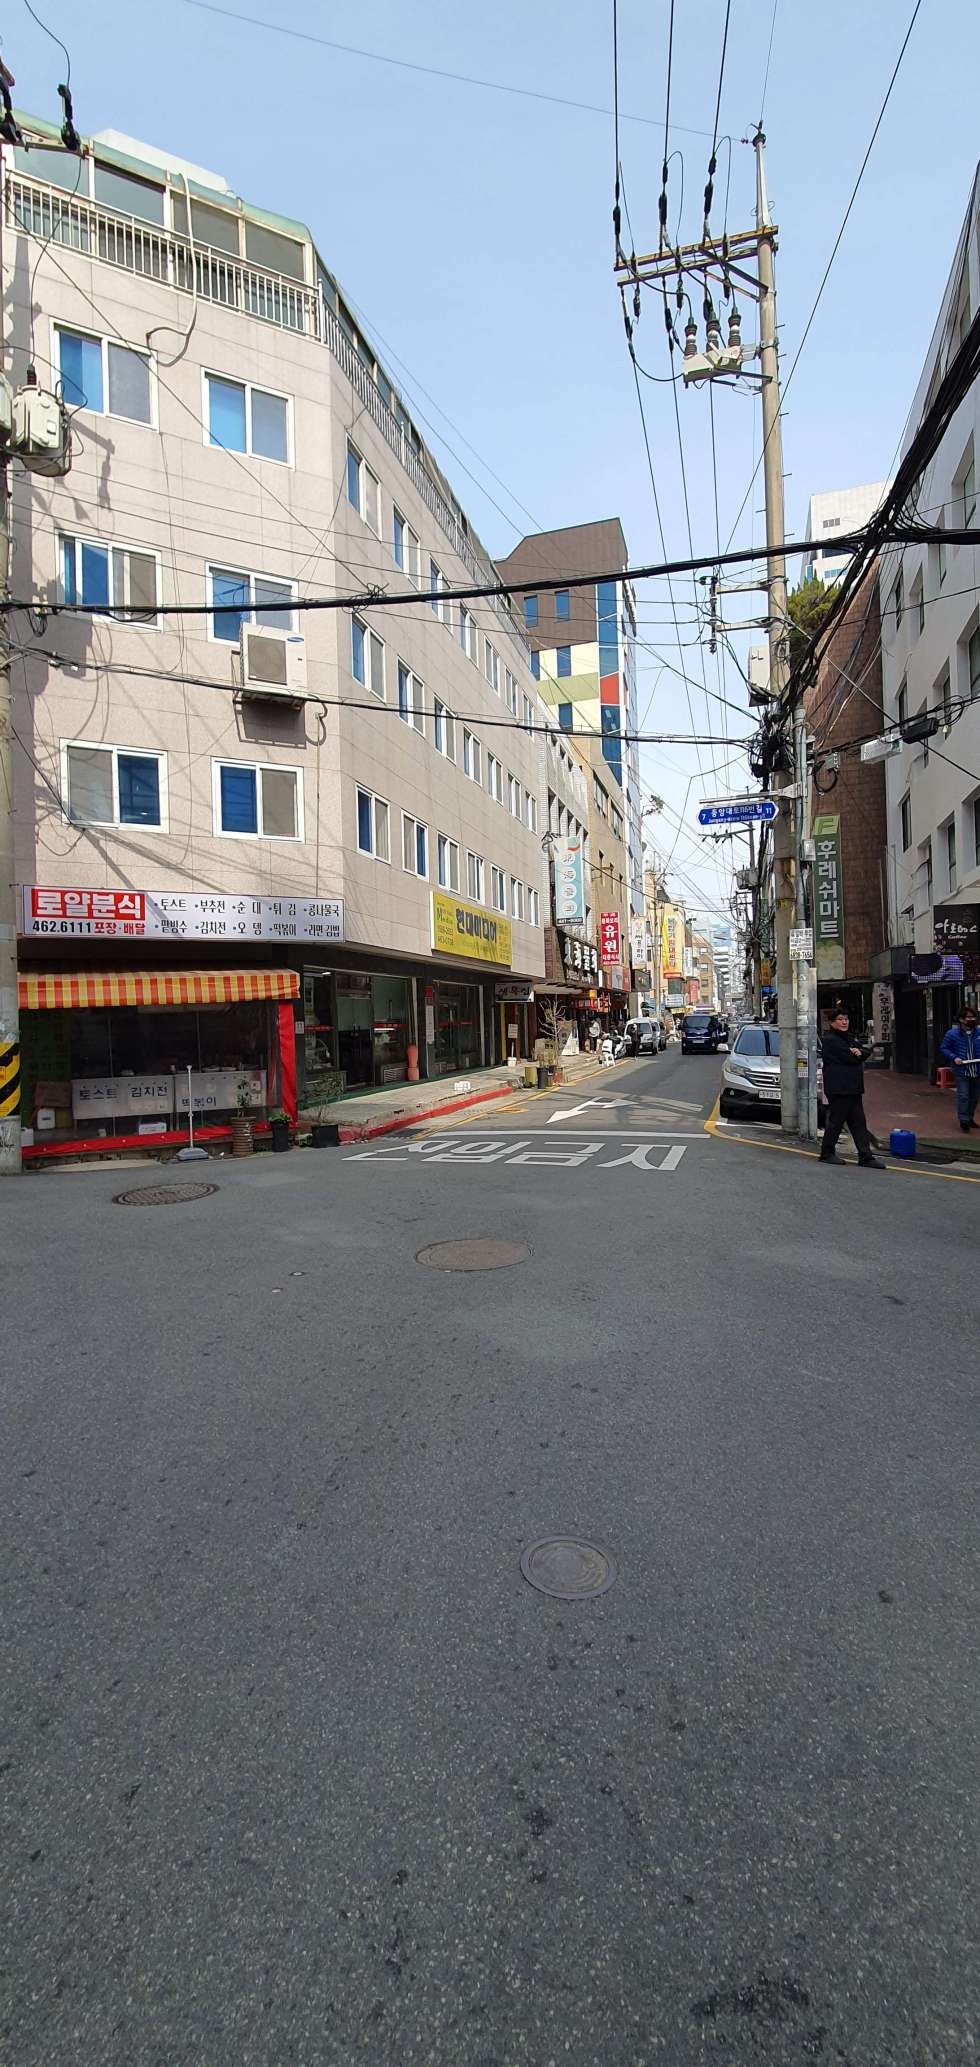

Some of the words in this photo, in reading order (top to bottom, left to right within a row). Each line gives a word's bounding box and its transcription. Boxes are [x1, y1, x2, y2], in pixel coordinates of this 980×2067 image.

[702, 813, 706, 821] 7
[766, 807, 772, 815] 11
[817, 840, 840, 939] 후레쉬마트
[36, 891, 141, 919] 로얄분식
[161, 898, 187, 912] 토스트
[200, 900, 225, 914] 부추전
[308, 903, 340, 917] 콩나물국
[32, 920, 91, 933] 462.6111
[161, 919, 188, 934] 팥빙수
[200, 921, 226, 935] 김치전
[273, 923, 297, 937] 떡볶이
[456, 908, 497, 943] 현대미디어
[79, 1088, 117, 1101] 토스트
[341, 1140, 688, 1171] 진입금지
